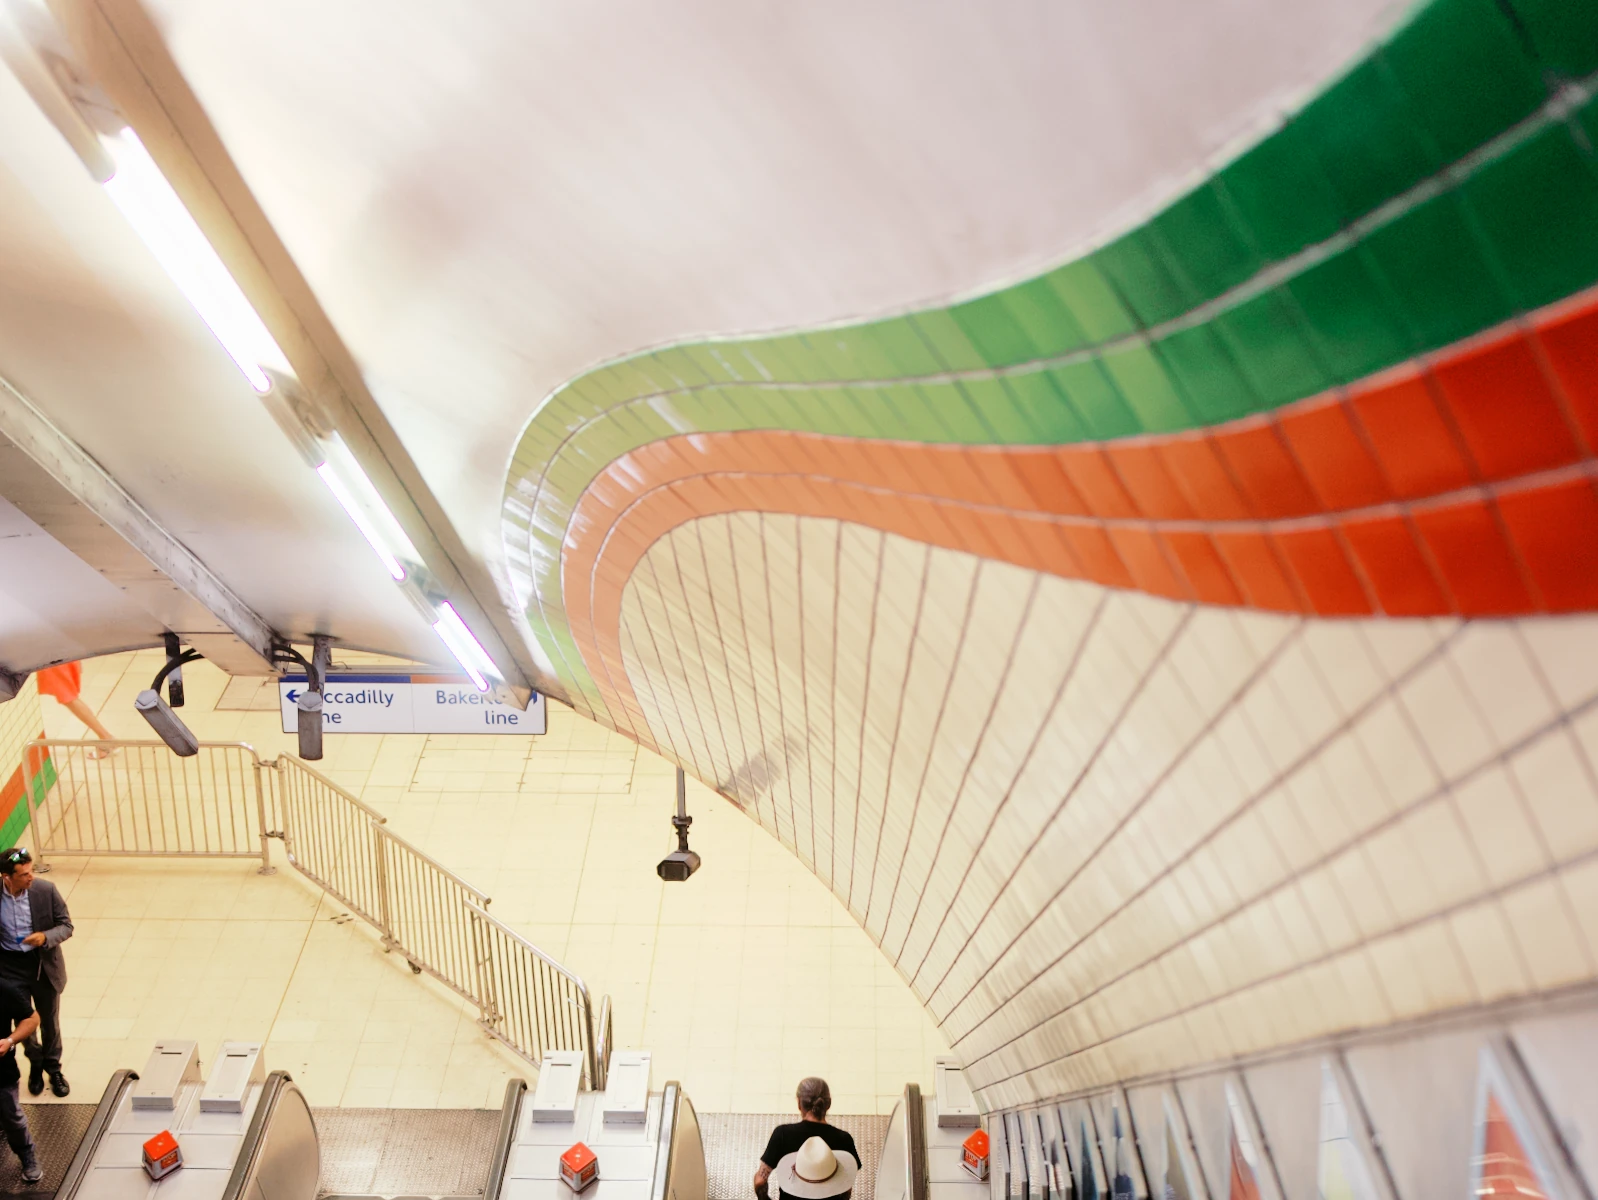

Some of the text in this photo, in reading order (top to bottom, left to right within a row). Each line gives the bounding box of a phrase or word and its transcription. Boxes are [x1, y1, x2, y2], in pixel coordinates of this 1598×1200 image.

[323, 689, 394, 708] ccadilly
[435, 689, 504, 705] Baker
[322, 712, 342, 724] ne
[485, 710, 519, 725] line
